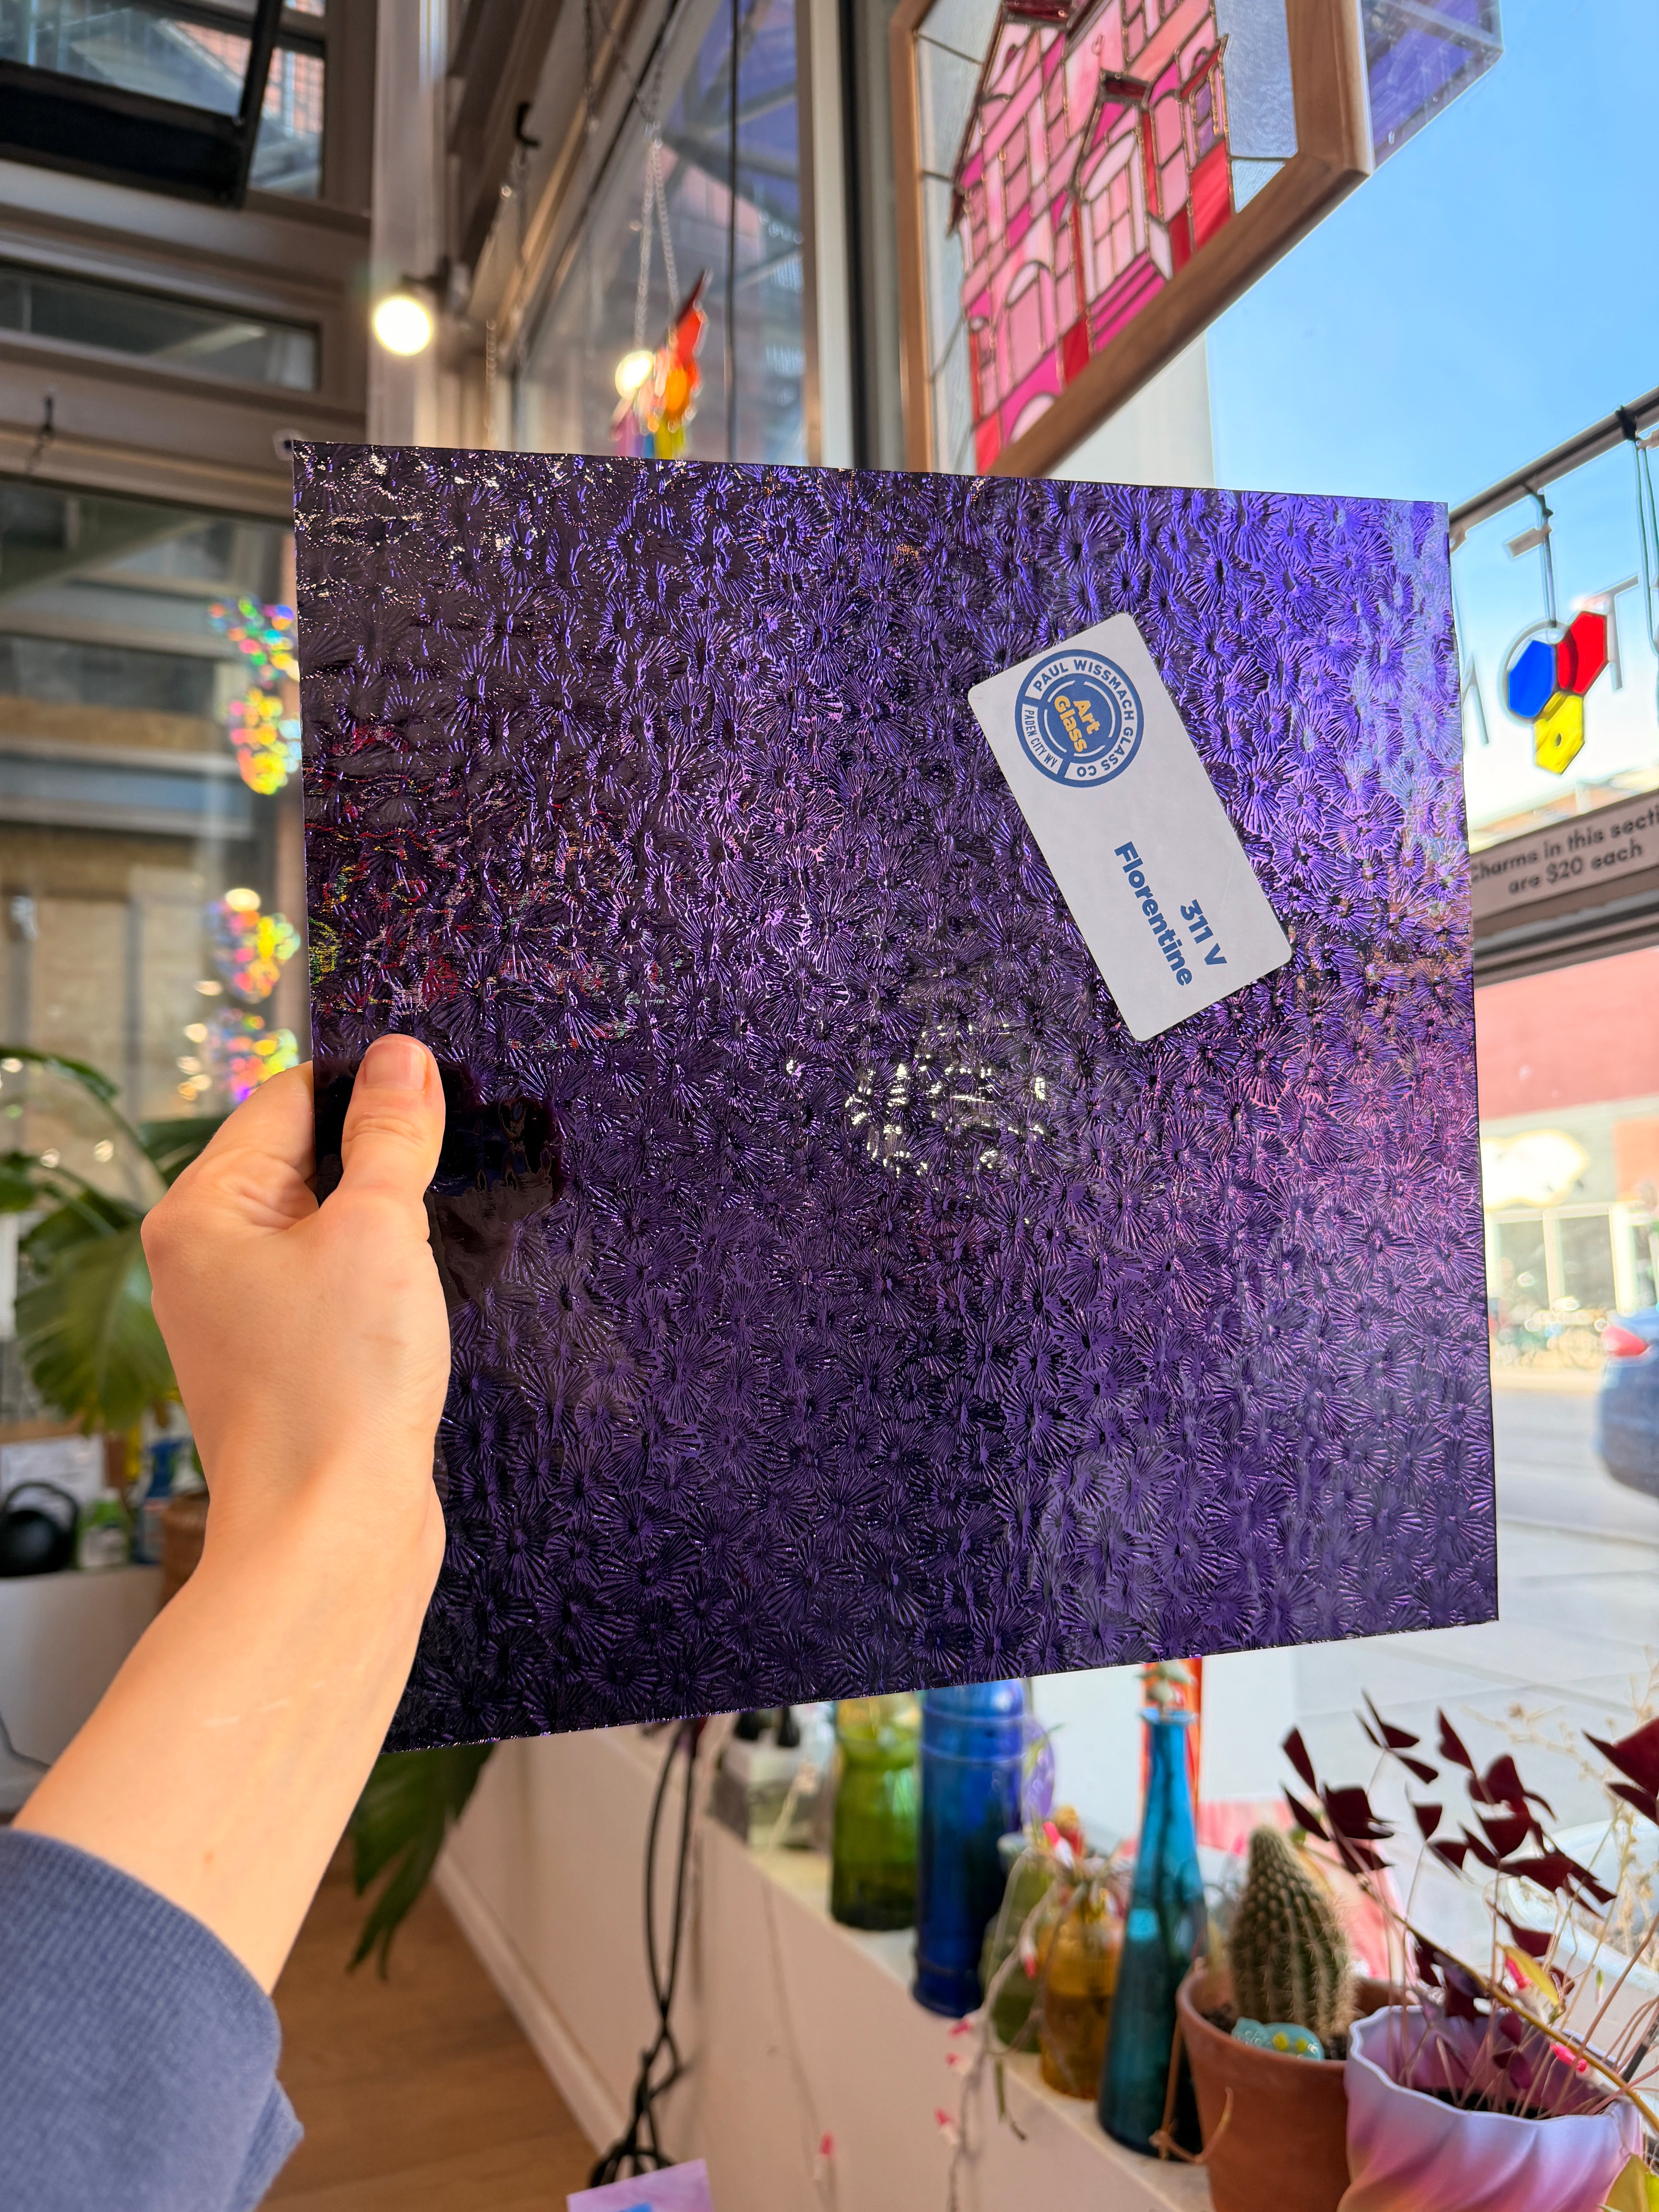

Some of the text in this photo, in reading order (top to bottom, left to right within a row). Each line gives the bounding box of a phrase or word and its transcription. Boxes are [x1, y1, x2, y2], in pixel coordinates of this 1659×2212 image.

[1025, 709, 1058, 768] PADEN CITY WV
[1033, 659, 1134, 777] PAUL WISSMACH GLASS CO
[1054, 696, 1087, 752] Glass
[1073, 700, 1100, 735] Art
[1509, 837, 1643, 895] are $20 each
[1543, 840, 1561, 859] in
[1568, 826, 1604, 852] this
[1114, 841, 1192, 986] Florentine
[1180, 899, 1227, 965] 311 V
